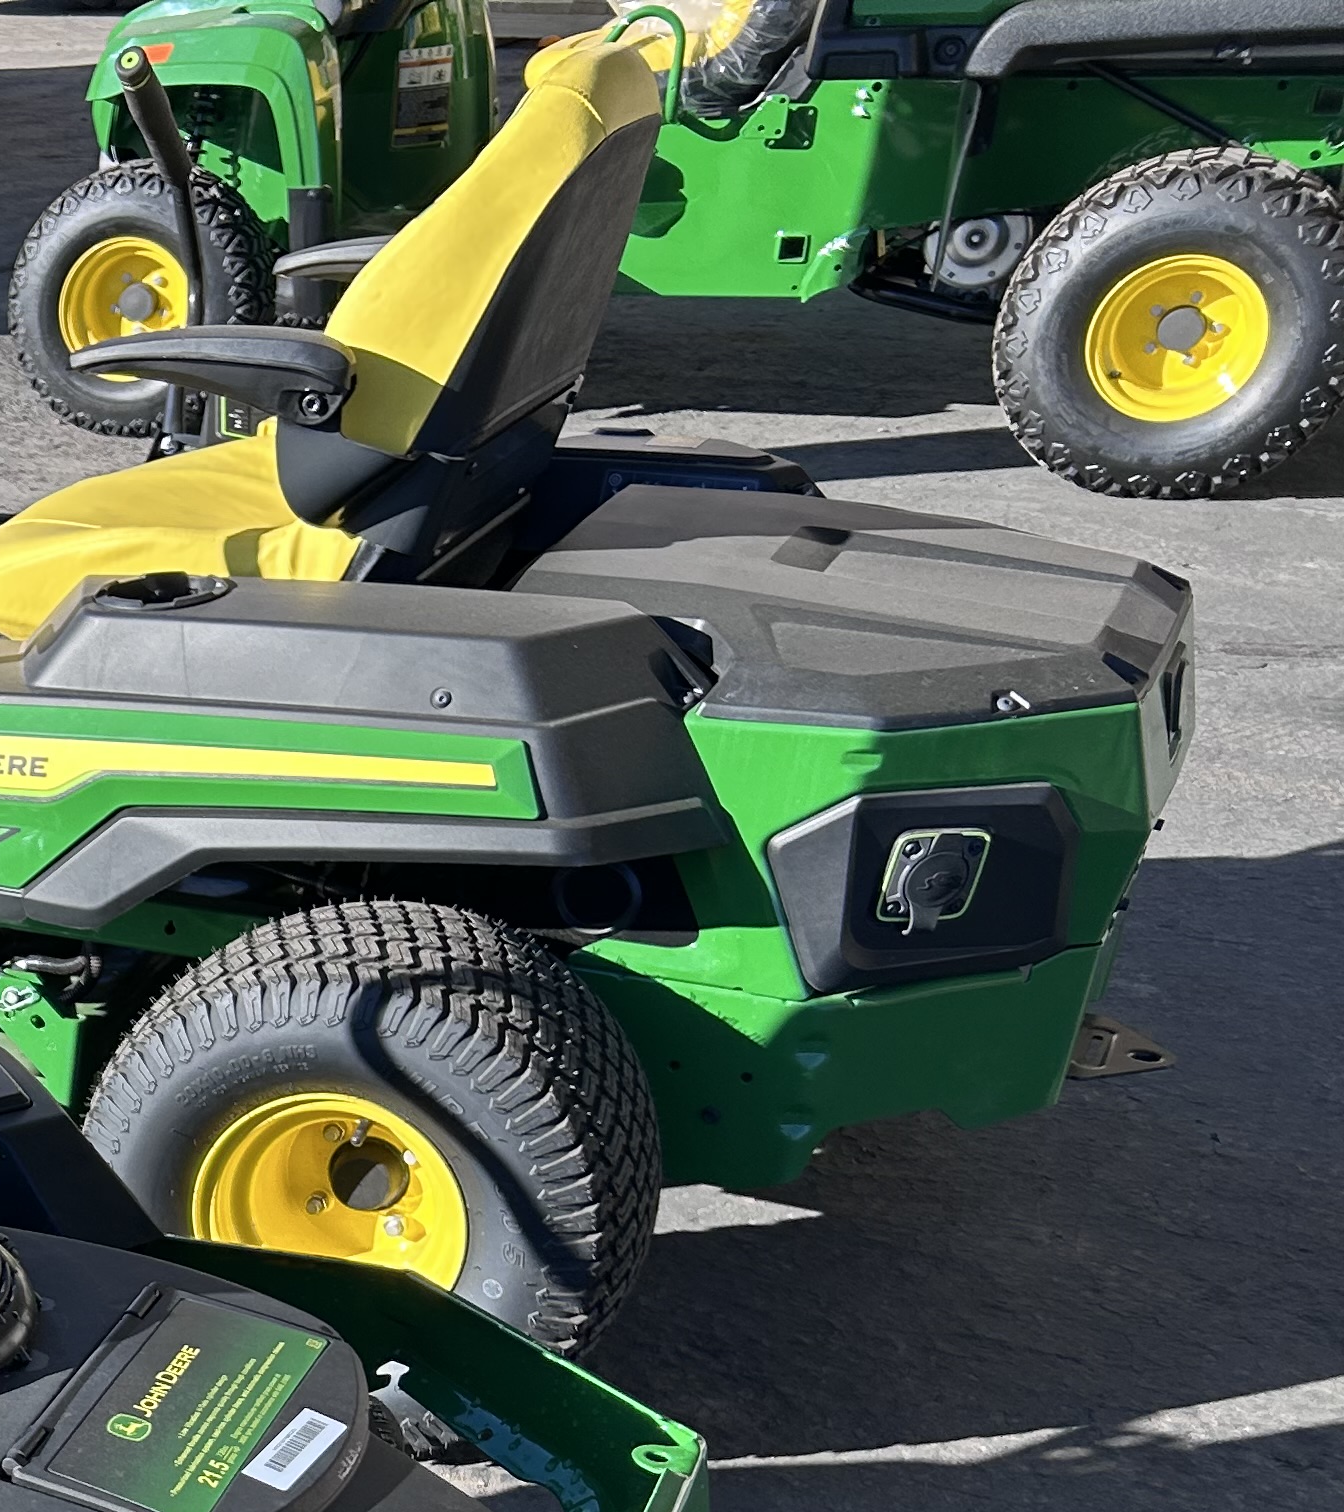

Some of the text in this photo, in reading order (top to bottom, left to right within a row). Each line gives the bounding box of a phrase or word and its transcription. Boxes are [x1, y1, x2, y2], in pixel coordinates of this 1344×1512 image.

[133, 1379, 172, 1417] JOHN
[155, 1344, 201, 1385] DEERE
[198, 1459, 230, 1489] 21.5
